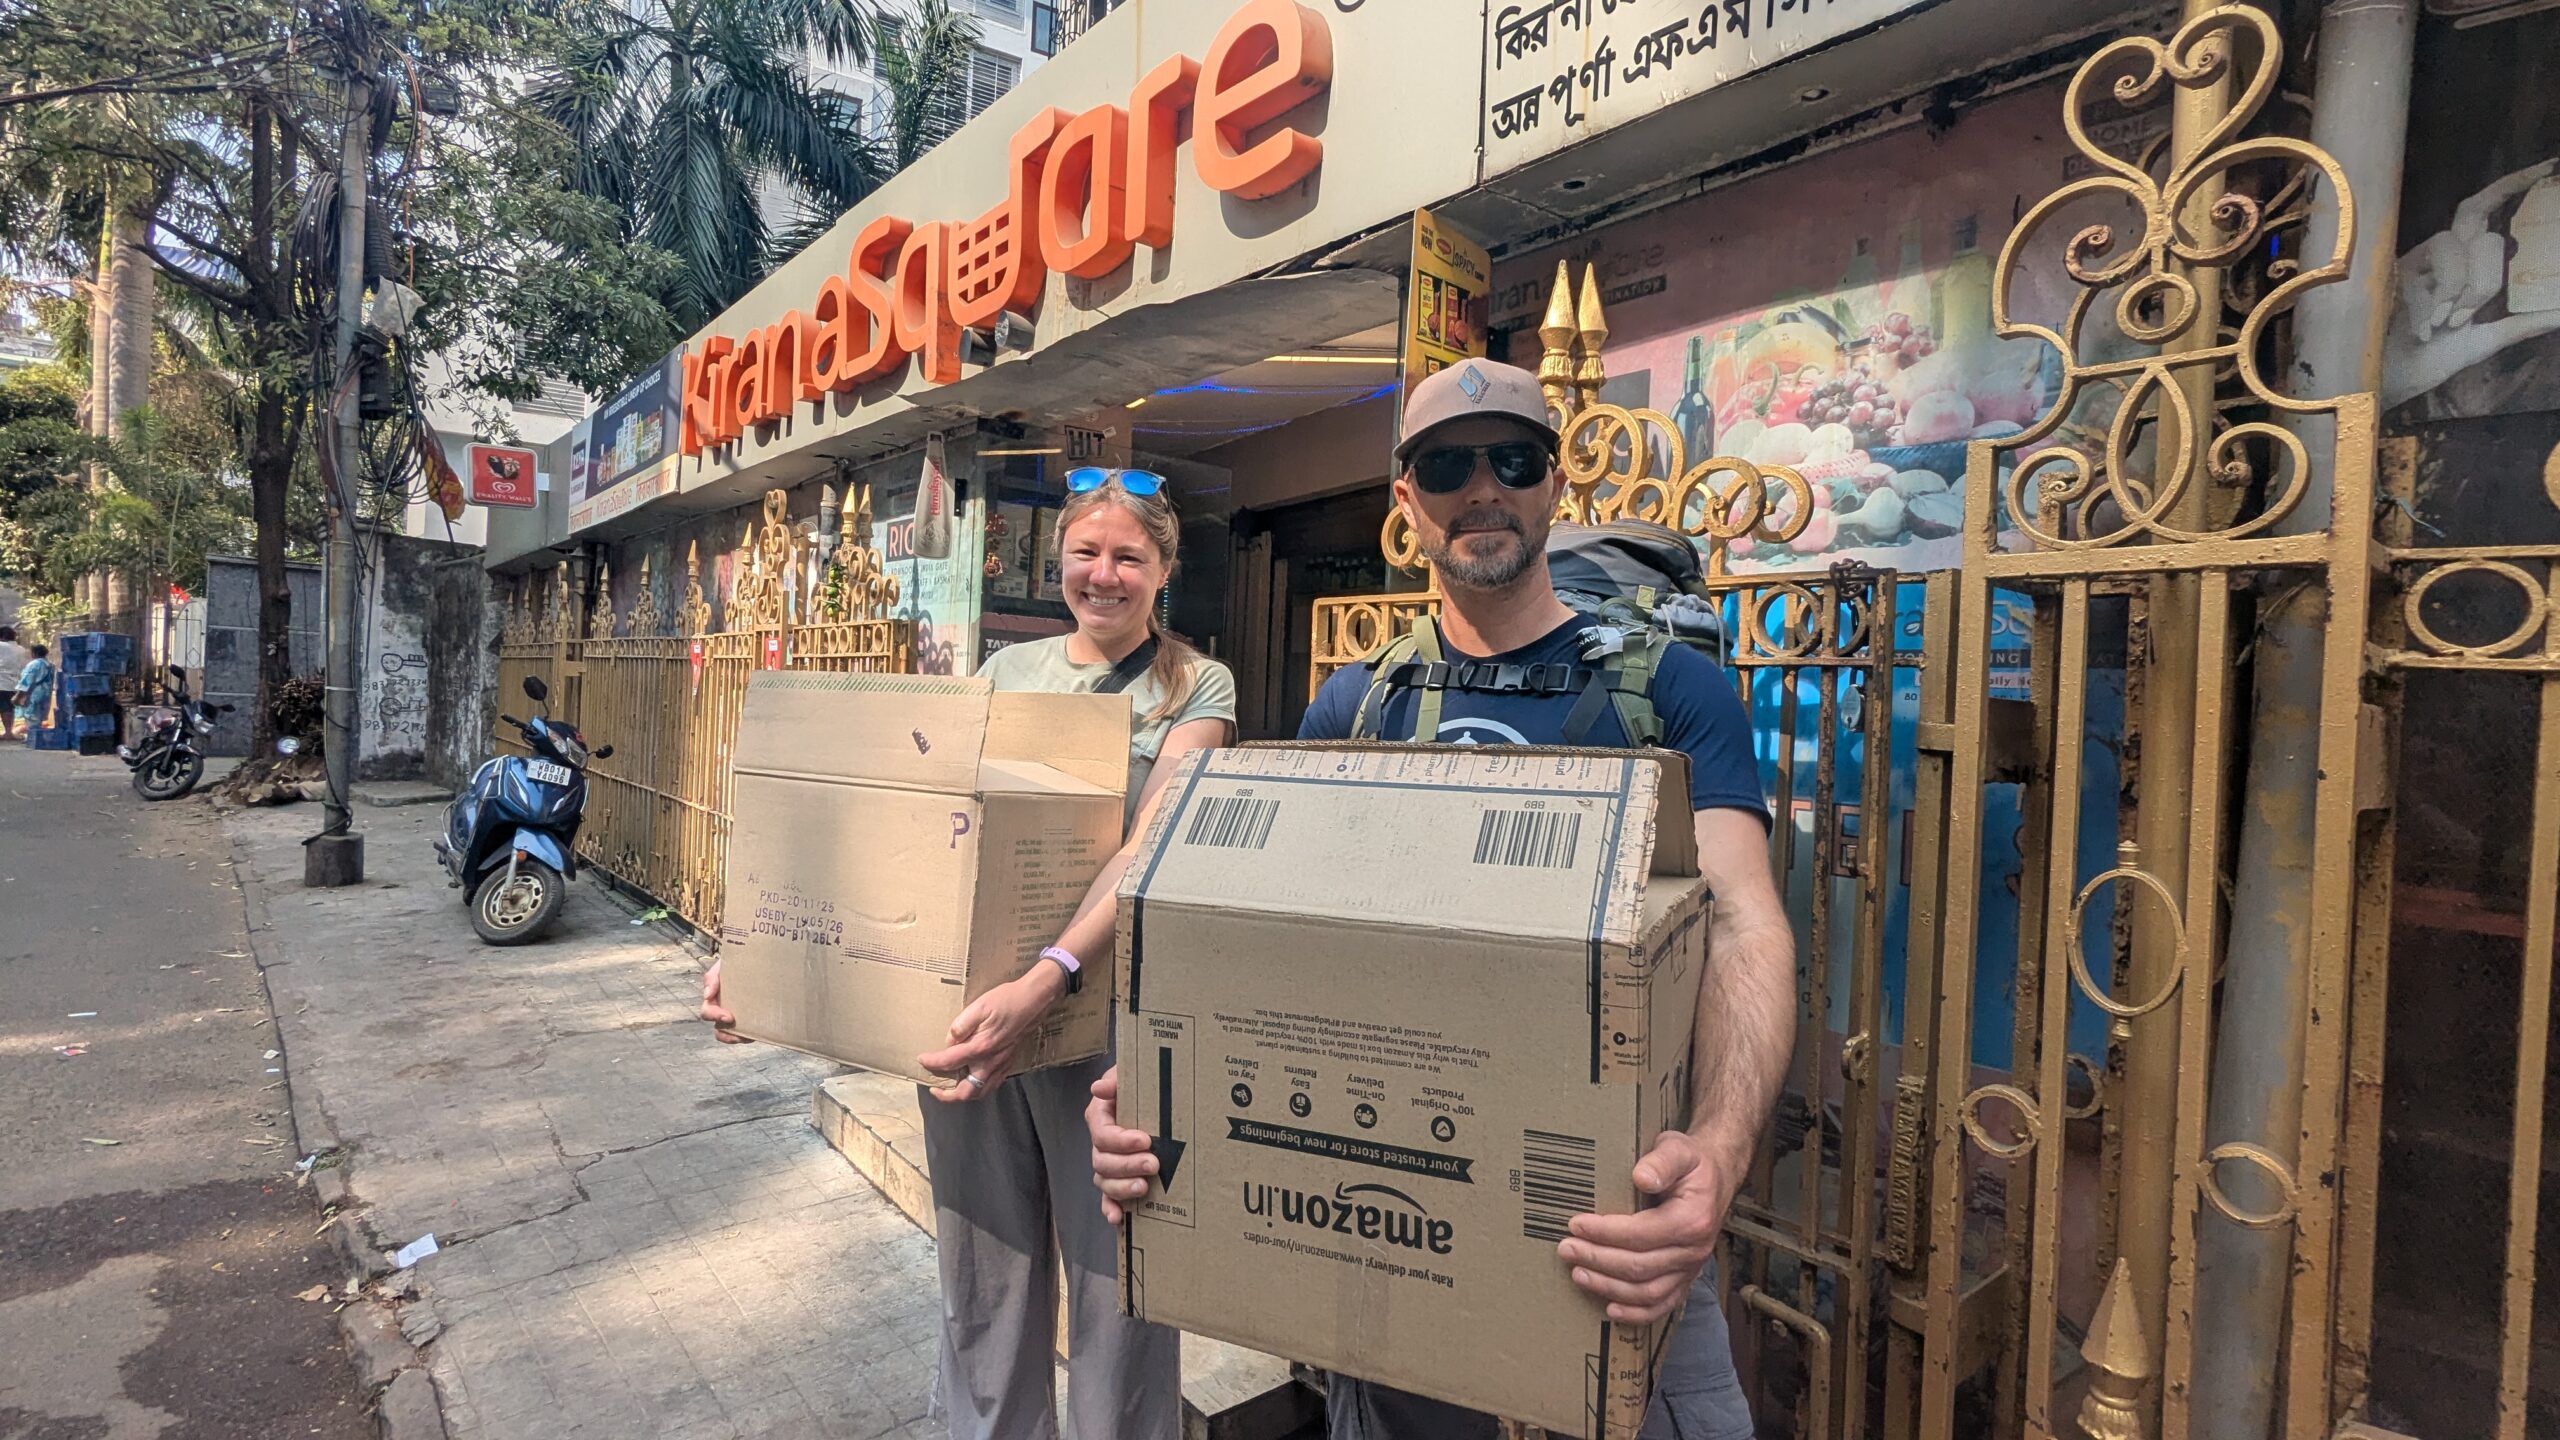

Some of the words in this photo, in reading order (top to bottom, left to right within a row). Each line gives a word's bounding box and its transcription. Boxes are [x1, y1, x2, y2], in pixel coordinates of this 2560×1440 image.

[888, 522, 914, 558] RIC
[1485, 754, 1499, 774] fres
[1554, 754, 1568, 776] prim
[1235, 788, 1254, 797] BB9
[1523, 800, 1545, 810] BB9
[1269, 1010, 1283, 1019] this
[1148, 1017, 1165, 1028] CARE
[1166, 1020, 1183, 1030] WITH
[1342, 1020, 1356, 1028] and
[1357, 1022, 1387, 1032] creative
[1244, 1028, 1264, 1037] paper
[1292, 1023, 1317, 1034] during
[1318, 1027, 1360, 1040] accordingly
[1389, 1026, 1403, 1034] get
[1404, 1028, 1426, 1037] could
[1153, 1029, 1179, 1040] HANDLE
[1266, 1031, 1295, 1041] recycled
[1362, 1034, 1398, 1046] segregate
[1320, 1038, 1336, 1046] with
[1337, 1041, 1358, 1050] made
[1400, 1040, 1425, 1050] Please
[1280, 1044, 1321, 1056] sustainable
[1384, 1048, 1415, 1059] Amazon
[1471, 1048, 1490, 1060] fully
[1329, 1050, 1359, 1062] building
[1416, 1053, 1431, 1061] this
[1433, 1054, 1450, 1063] why
[1225, 1055, 1259, 1070] Delivery
[1371, 1057, 1412, 1068] committed
[1460, 1057, 1479, 1068] That
[1284, 1065, 1317, 1078] Returns
[1428, 1065, 1441, 1073] We
[1241, 1070, 1255, 1080] Pay
[1291, 1077, 1310, 1089] Easy
[1347, 1073, 1384, 1089] Delivery
[1346, 1087, 1385, 1101] On-Time
[1422, 1086, 1464, 1101] Products
[1411, 1097, 1450, 1112] Original
[1240, 1125, 1300, 1147] beginnings
[1303, 1137, 1326, 1148] new
[1330, 1142, 1347, 1156] for
[1350, 1144, 1380, 1159] store
[1383, 1150, 1426, 1168] trusted
[1429, 1160, 1459, 1174] your
[1509, 1168, 1521, 1192] BB9
[1145, 1201, 1155, 1210] UP
[1156, 1203, 1171, 1212] SIDE
[1172, 1207, 1187, 1217] THIS
[1243, 1181, 1454, 1255] amazon.in
[1365, 1257, 1406, 1277] delivery:
[1408, 1267, 1430, 1282] your
[1432, 1273, 1453, 1288] Rate
